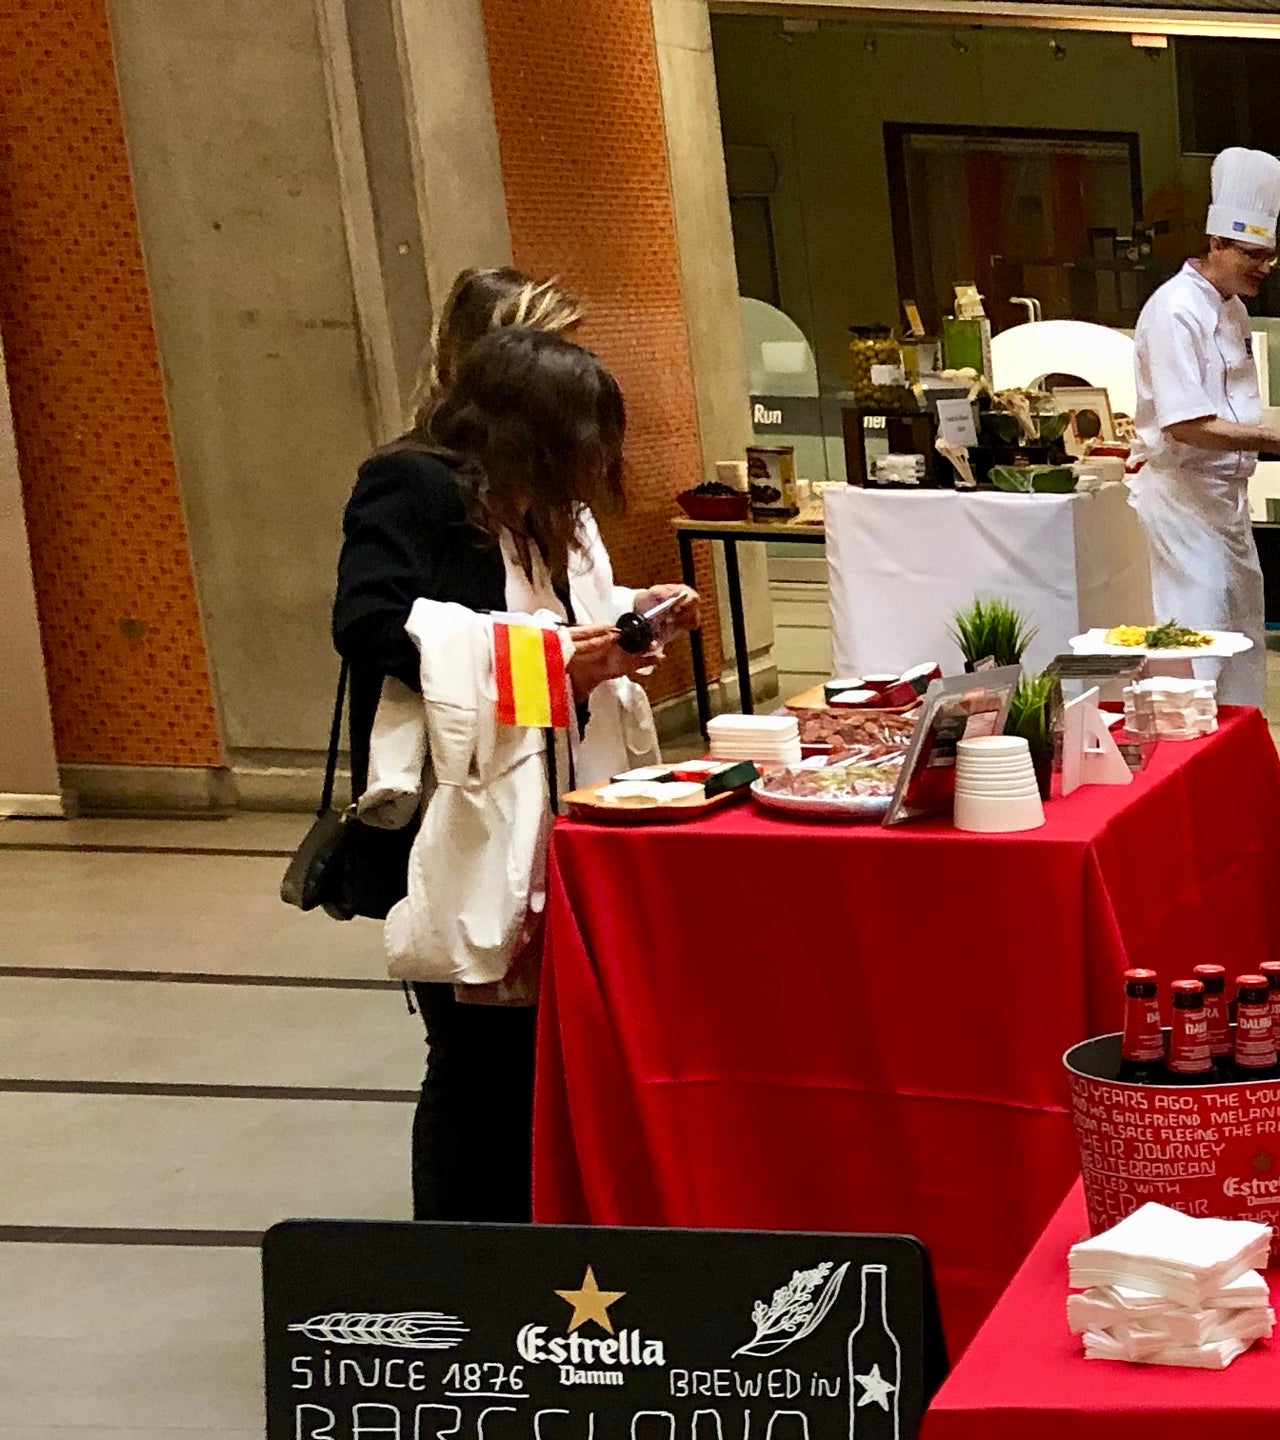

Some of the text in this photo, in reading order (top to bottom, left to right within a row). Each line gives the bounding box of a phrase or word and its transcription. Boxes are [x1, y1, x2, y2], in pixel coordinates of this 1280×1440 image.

[754, 404, 782, 424] Run
[1132, 1142, 1226, 1160] JOURNEY
[516, 1323, 666, 1367] Estrella
[442, 1362, 526, 1392] 1876
[559, 1365, 625, 1385] Damm
[669, 1369, 801, 1398] BREWED
